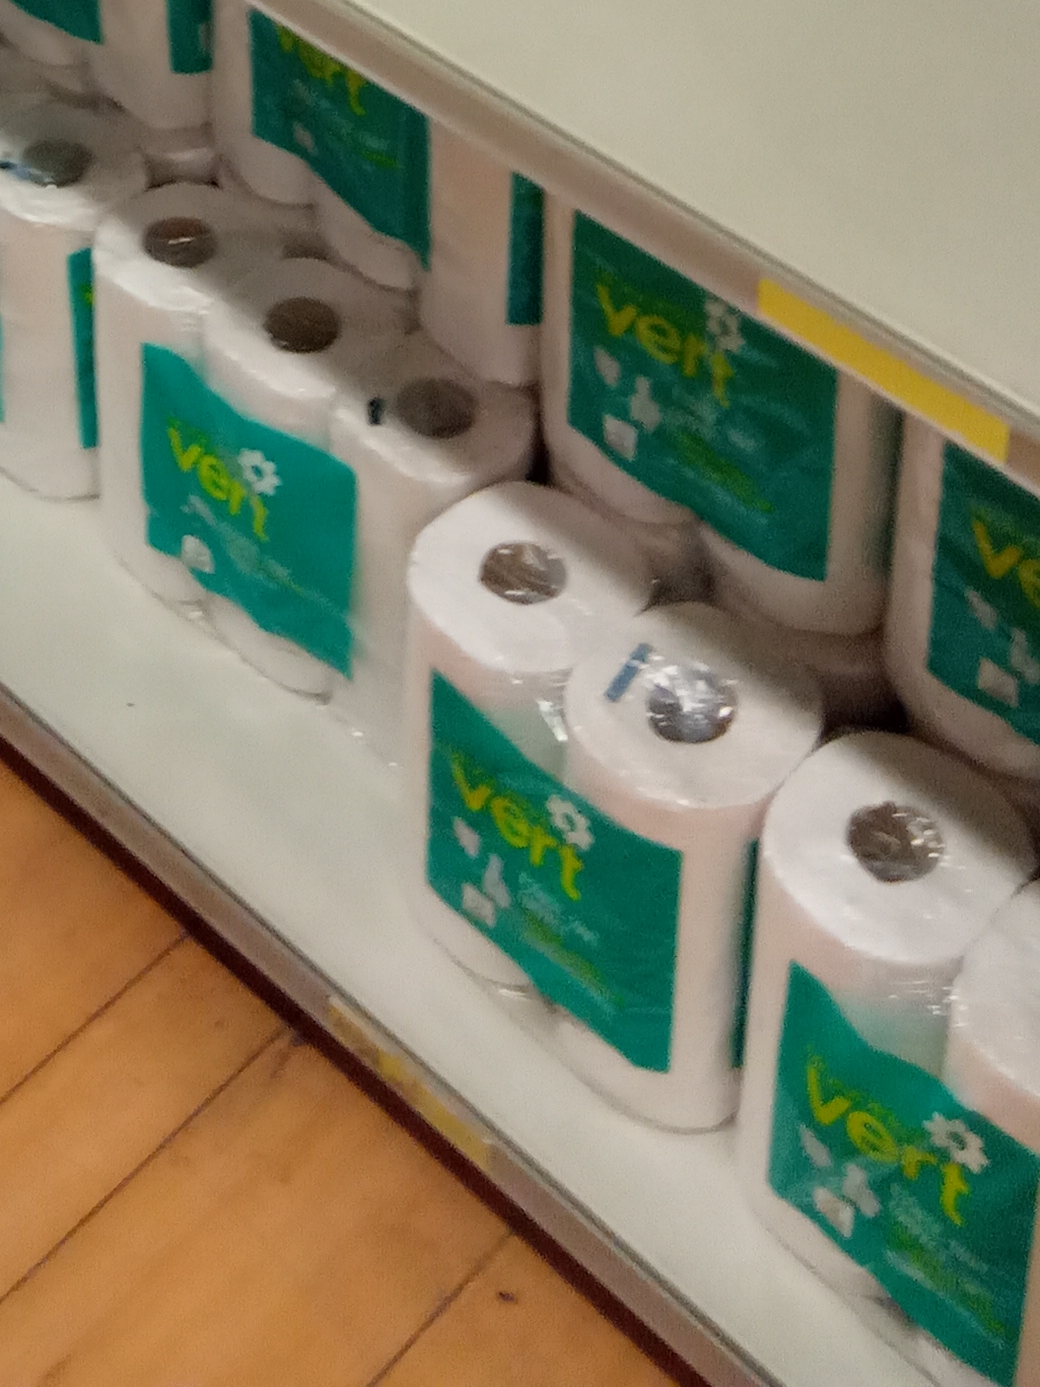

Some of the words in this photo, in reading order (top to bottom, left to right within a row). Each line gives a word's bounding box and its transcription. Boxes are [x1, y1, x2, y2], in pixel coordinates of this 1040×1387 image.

[596, 280, 734, 409] vert
[167, 425, 270, 543] vert
[451, 749, 585, 902] vert
[807, 1062, 971, 1228] vert
